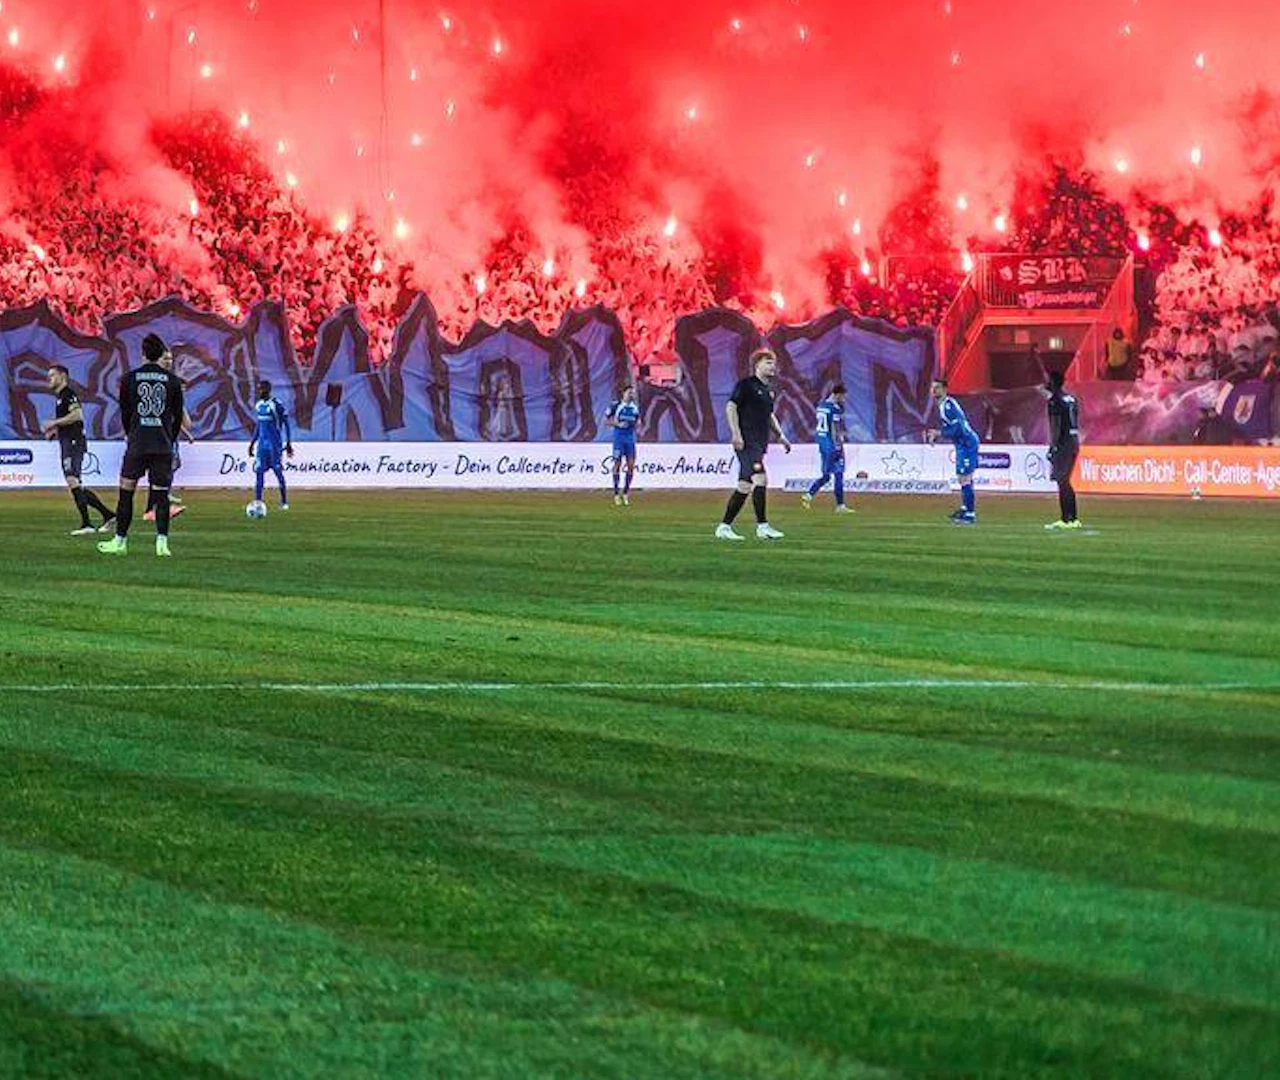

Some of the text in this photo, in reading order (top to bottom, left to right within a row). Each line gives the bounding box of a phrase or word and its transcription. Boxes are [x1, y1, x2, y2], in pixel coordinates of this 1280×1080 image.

[220, 453, 246, 475] Die
[376, 455, 439, 478] Factory
[455, 455, 491, 475] Dein
[496, 455, 574, 475] Callcenter
[581, 458, 595, 474] in
[1080, 459, 1100, 481] Wir
[1101, 459, 1143, 483] suchen
